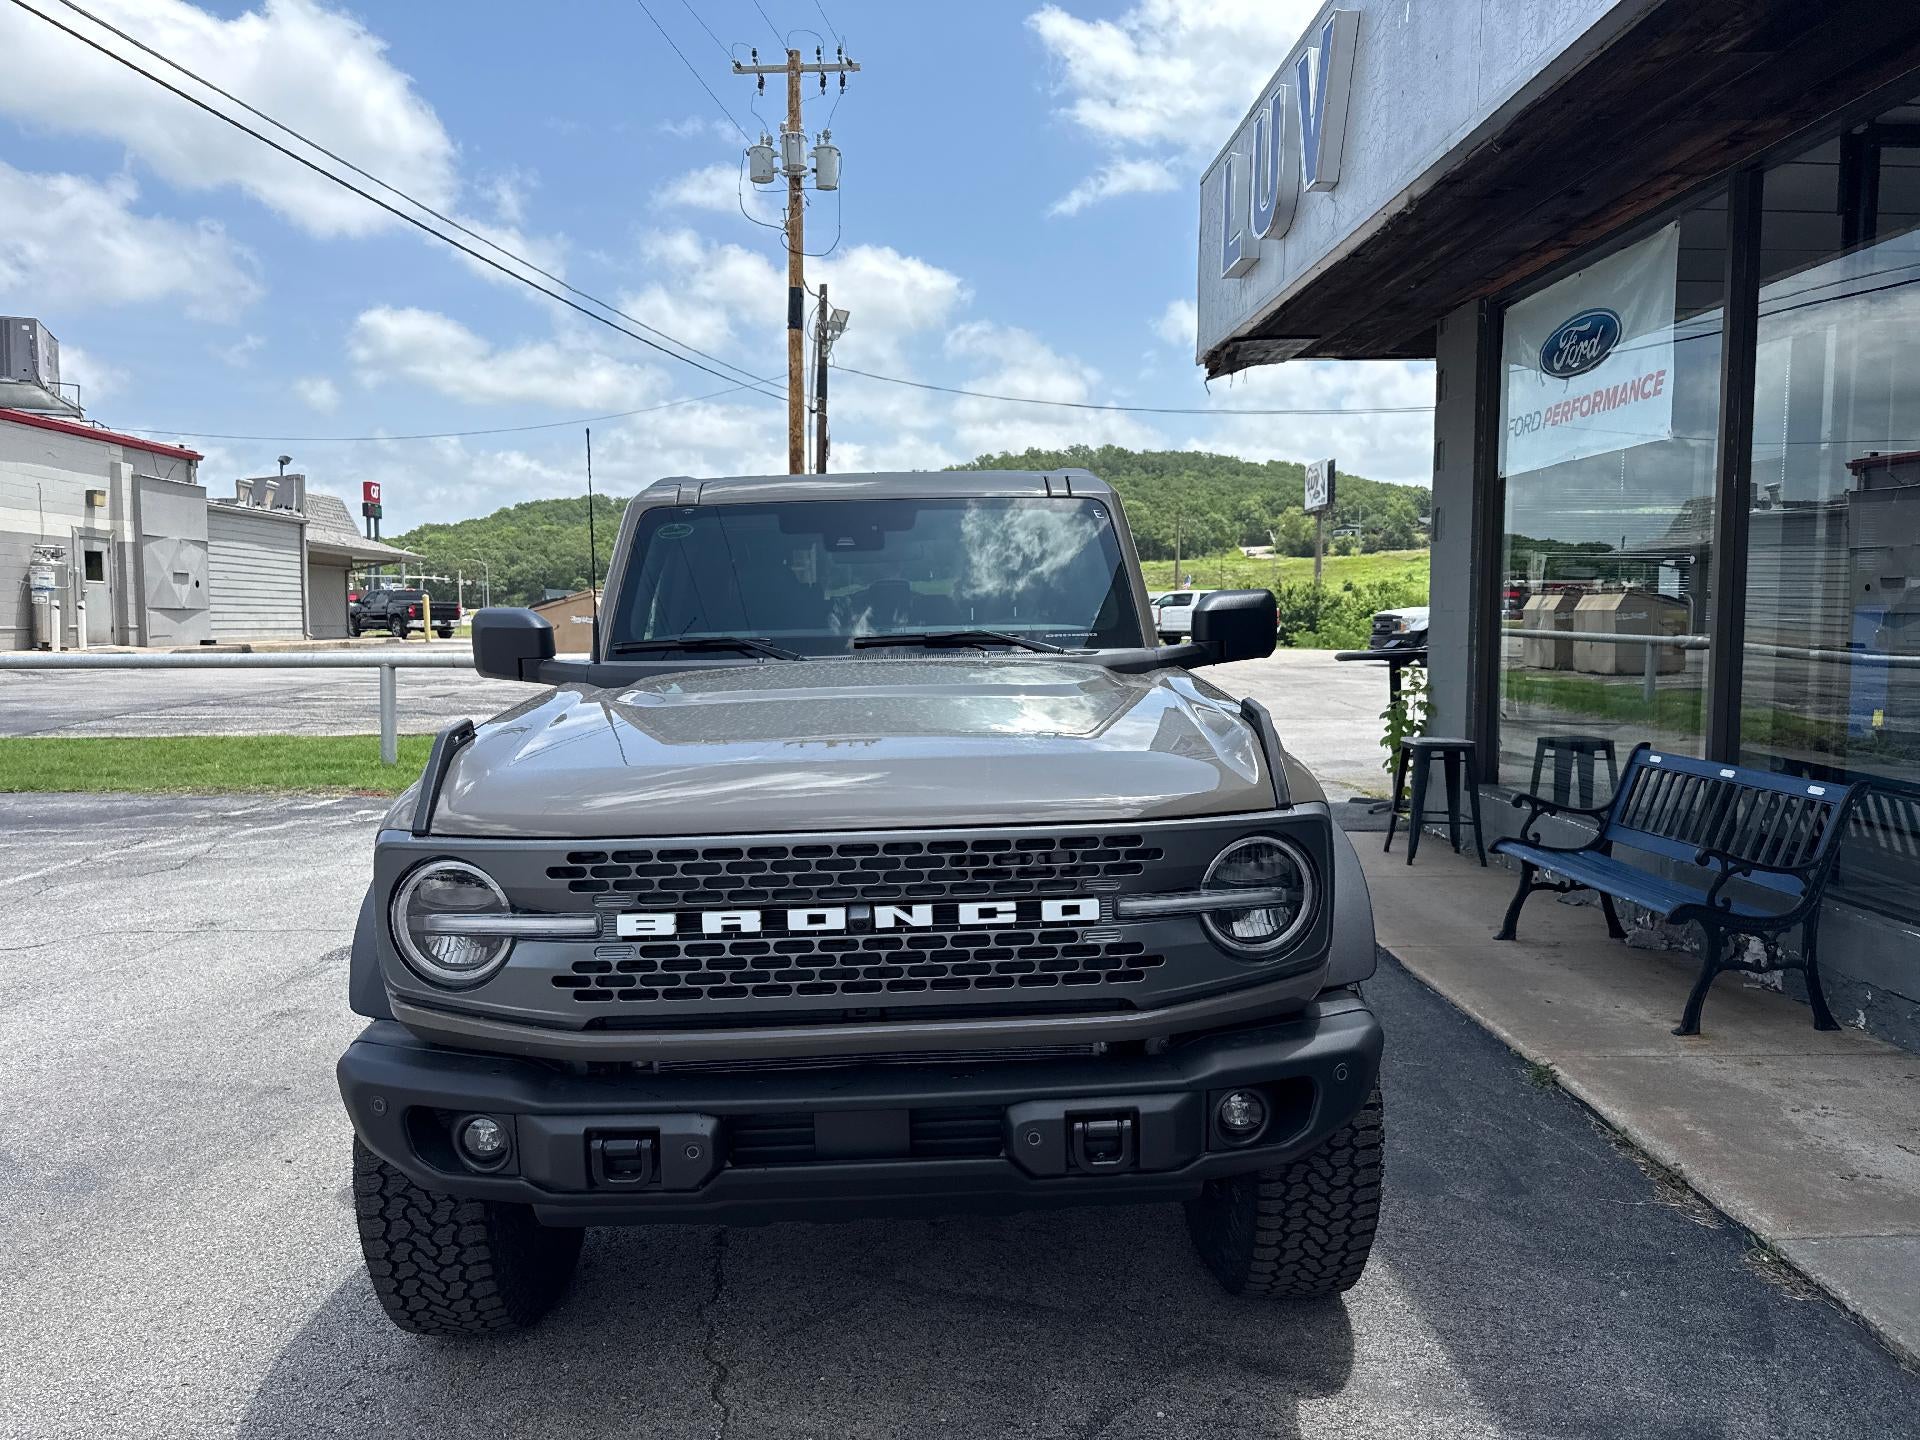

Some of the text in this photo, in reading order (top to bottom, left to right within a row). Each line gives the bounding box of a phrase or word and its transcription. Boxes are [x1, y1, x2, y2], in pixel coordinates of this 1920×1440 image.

[1221, 9, 1360, 278] LUV
[1553, 320, 1603, 370] Ford
[1508, 369, 1666, 437] FORD PERFORMANCE
[370, 484, 380, 499] QT
[616, 898, 1100, 937] BRONCO
